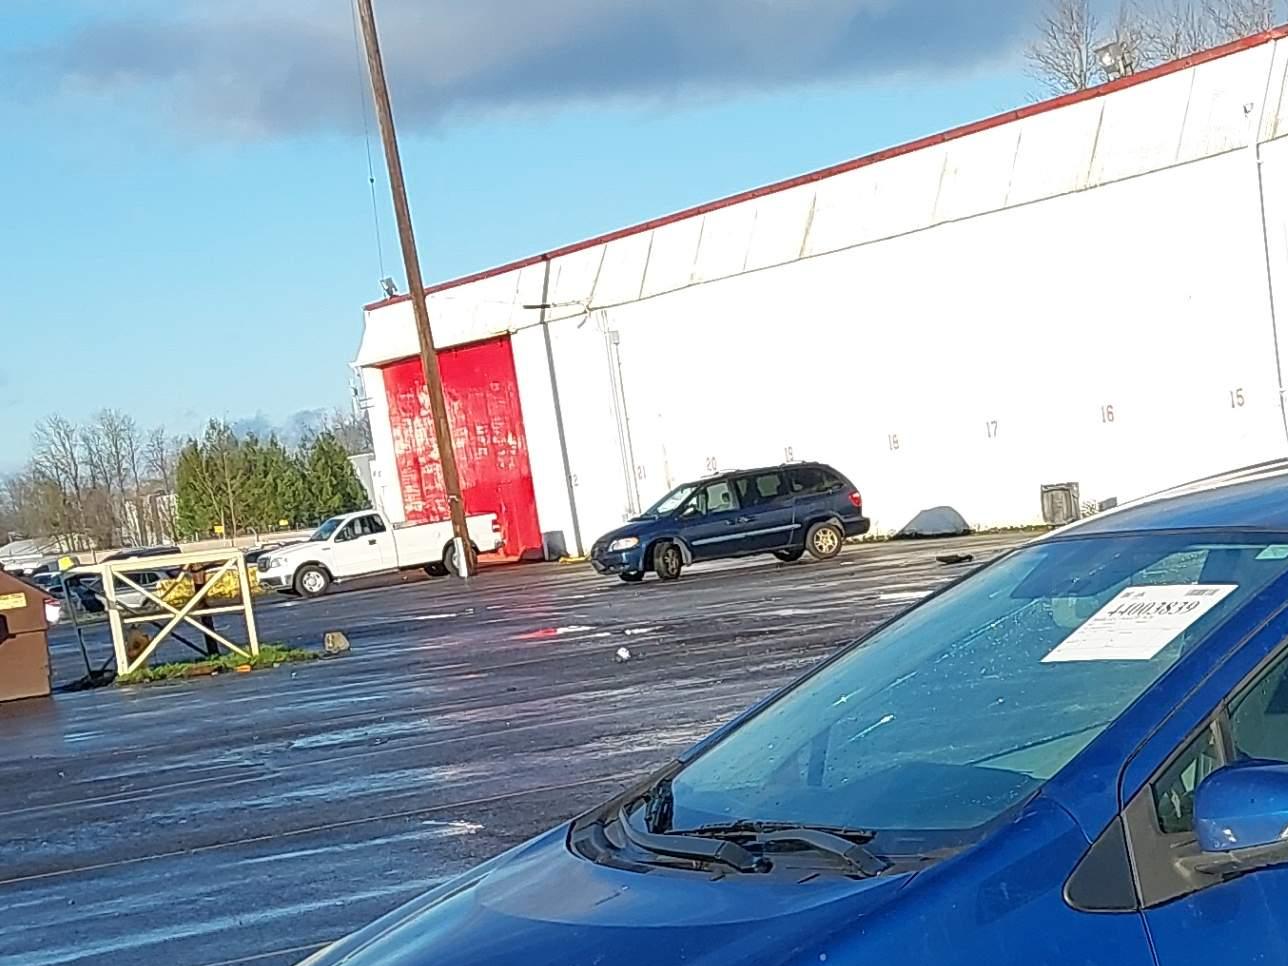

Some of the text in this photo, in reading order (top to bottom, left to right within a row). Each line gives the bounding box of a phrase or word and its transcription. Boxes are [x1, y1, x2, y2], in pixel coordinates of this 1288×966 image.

[1230, 387, 1246, 409] 15
[1101, 404, 1115, 424] 16
[986, 419, 998, 439] 17
